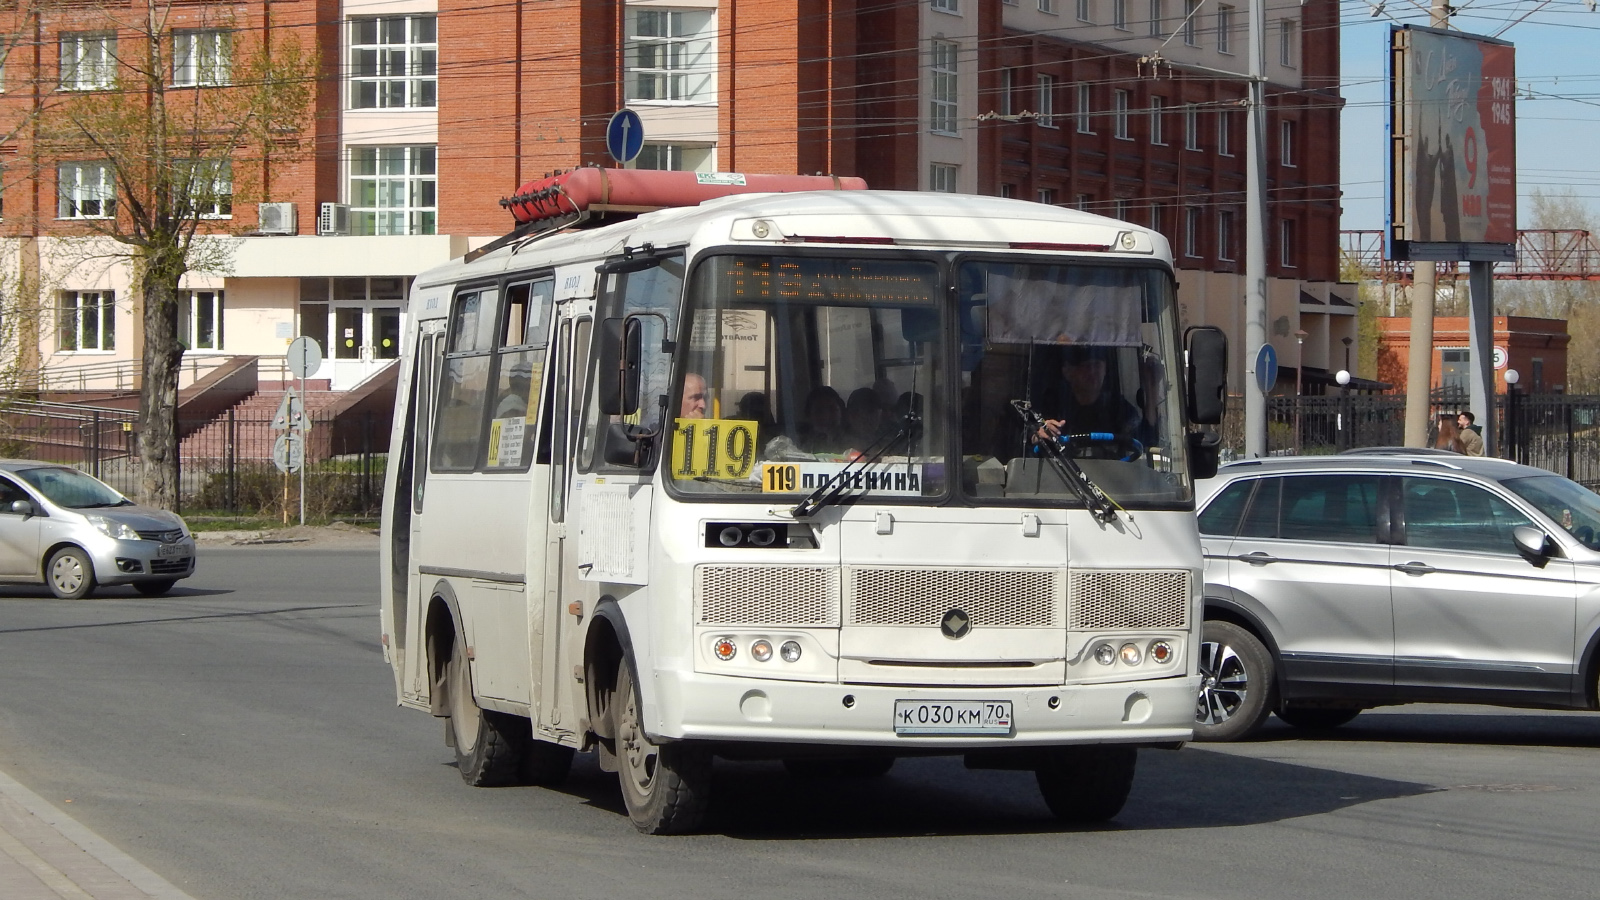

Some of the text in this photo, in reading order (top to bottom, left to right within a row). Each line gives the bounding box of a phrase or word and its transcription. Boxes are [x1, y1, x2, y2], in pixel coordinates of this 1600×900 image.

[1491, 76, 1511, 101] 1941
[1491, 101, 1511, 126] 1945
[1464, 125, 1478, 190] 9
[678, 423, 754, 478] 119
[766, 465, 797, 491] 119
[986, 704, 1004, 719] 70
